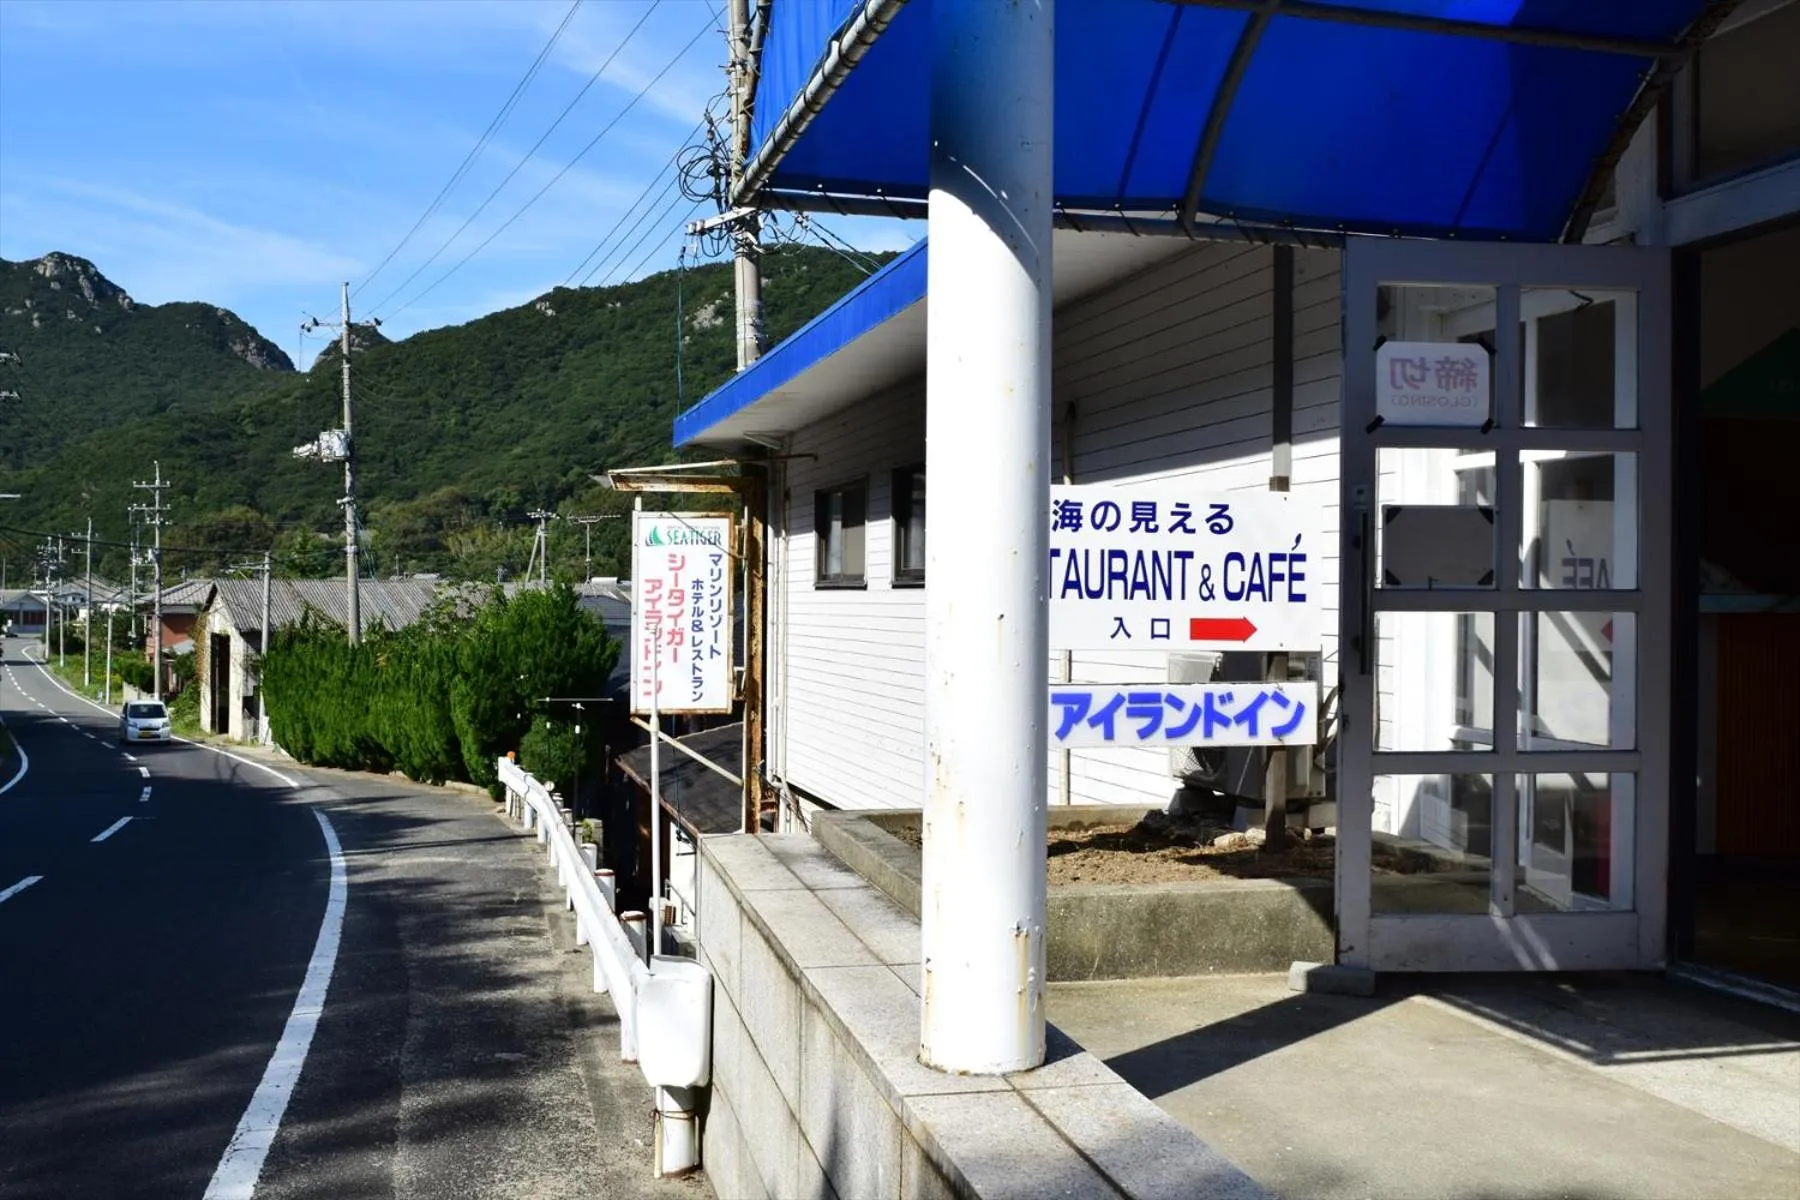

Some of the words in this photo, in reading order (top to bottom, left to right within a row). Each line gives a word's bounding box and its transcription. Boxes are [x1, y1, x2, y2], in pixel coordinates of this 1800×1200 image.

[1052, 499, 1234, 535] 海の見える
[1199, 564, 1216, 602] &
[1223, 533, 1307, 602] CAFÉ
[667, 553, 686, 663] シータイガー
[1110, 617, 1170, 640] 入口
[1051, 691, 1306, 741] アイランドイン
